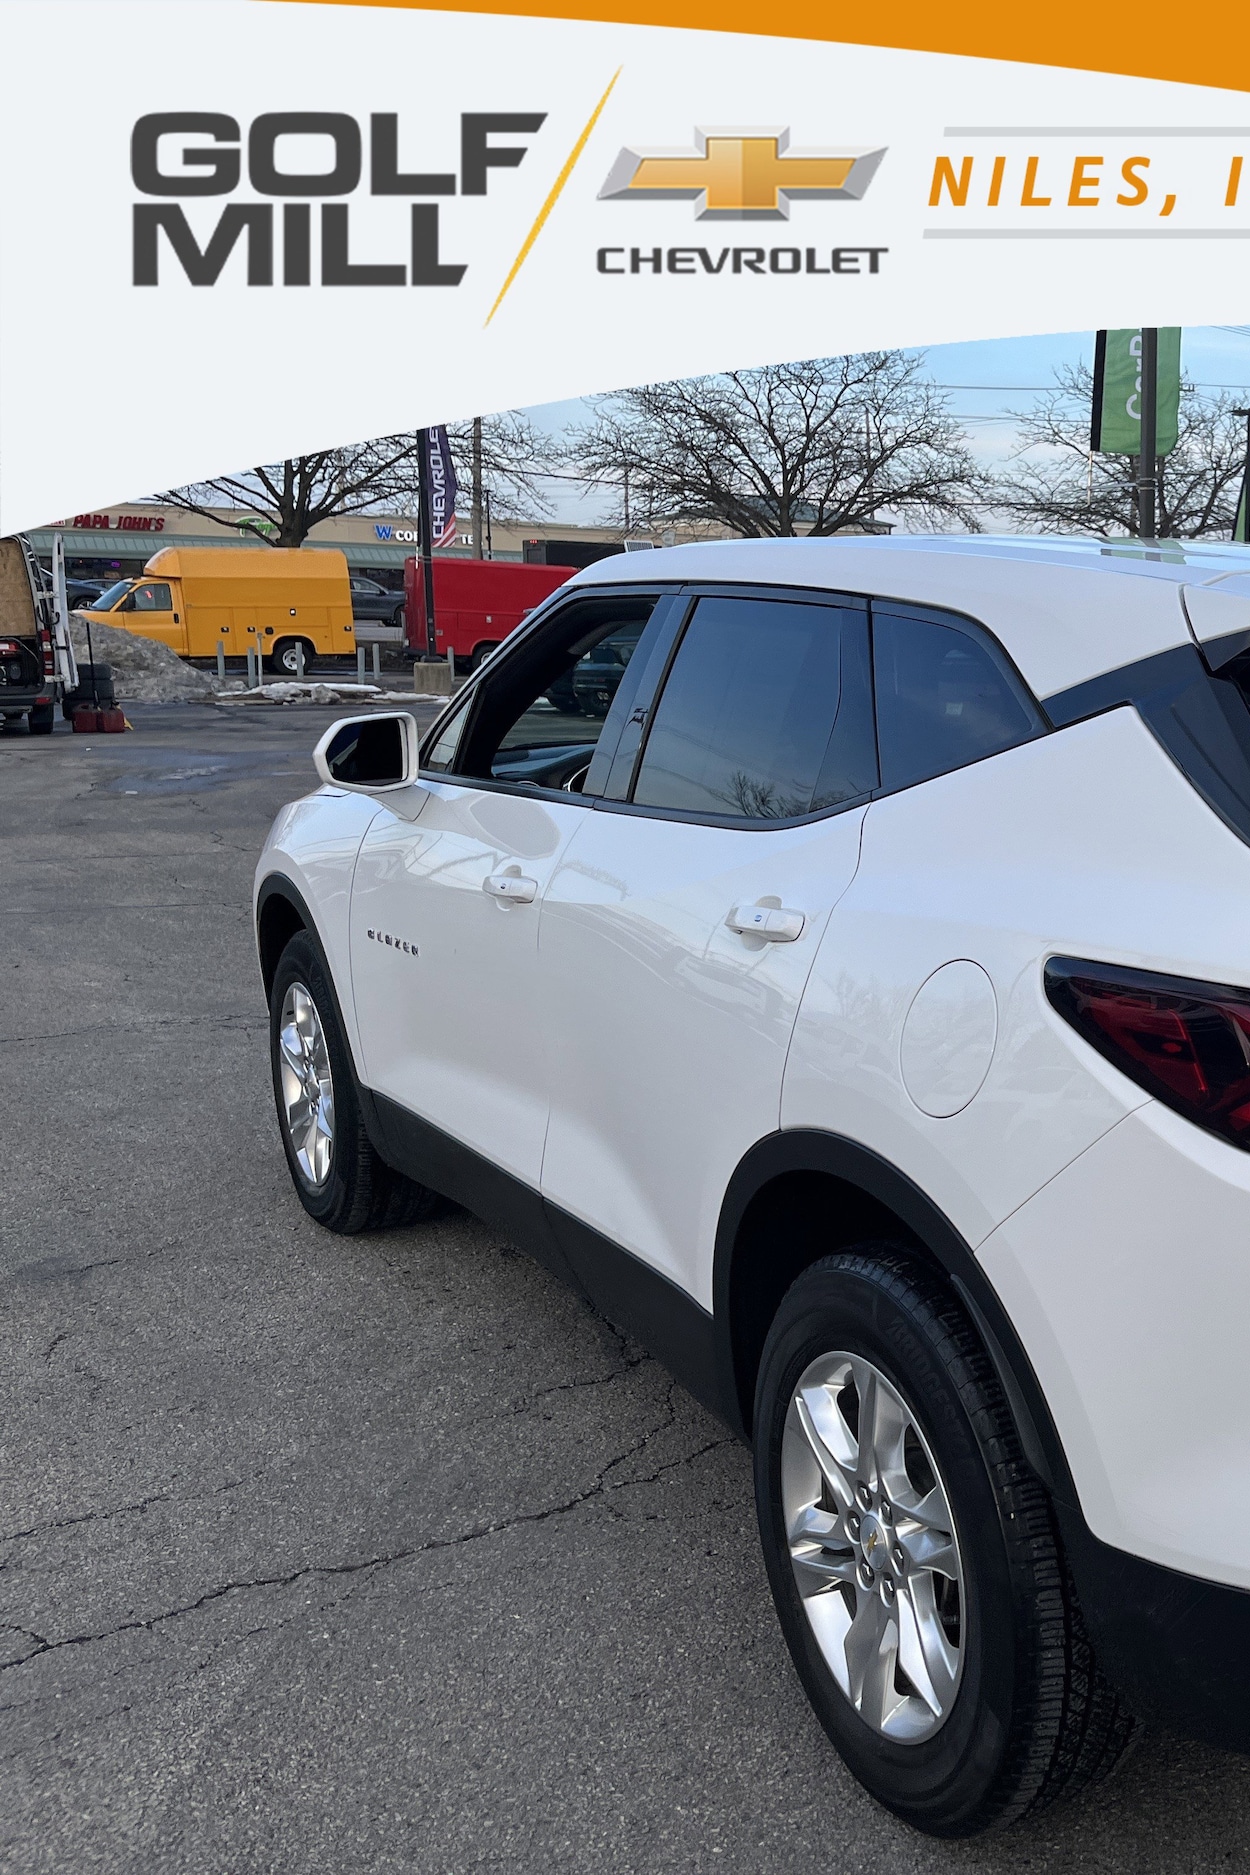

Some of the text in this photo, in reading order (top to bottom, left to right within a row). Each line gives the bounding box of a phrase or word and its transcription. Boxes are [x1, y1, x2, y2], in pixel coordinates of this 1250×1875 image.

[429, 427, 447, 539] CHEVROLE
[73, 514, 110, 530] PAPA
[366, 928, 420, 957] BLAZER
